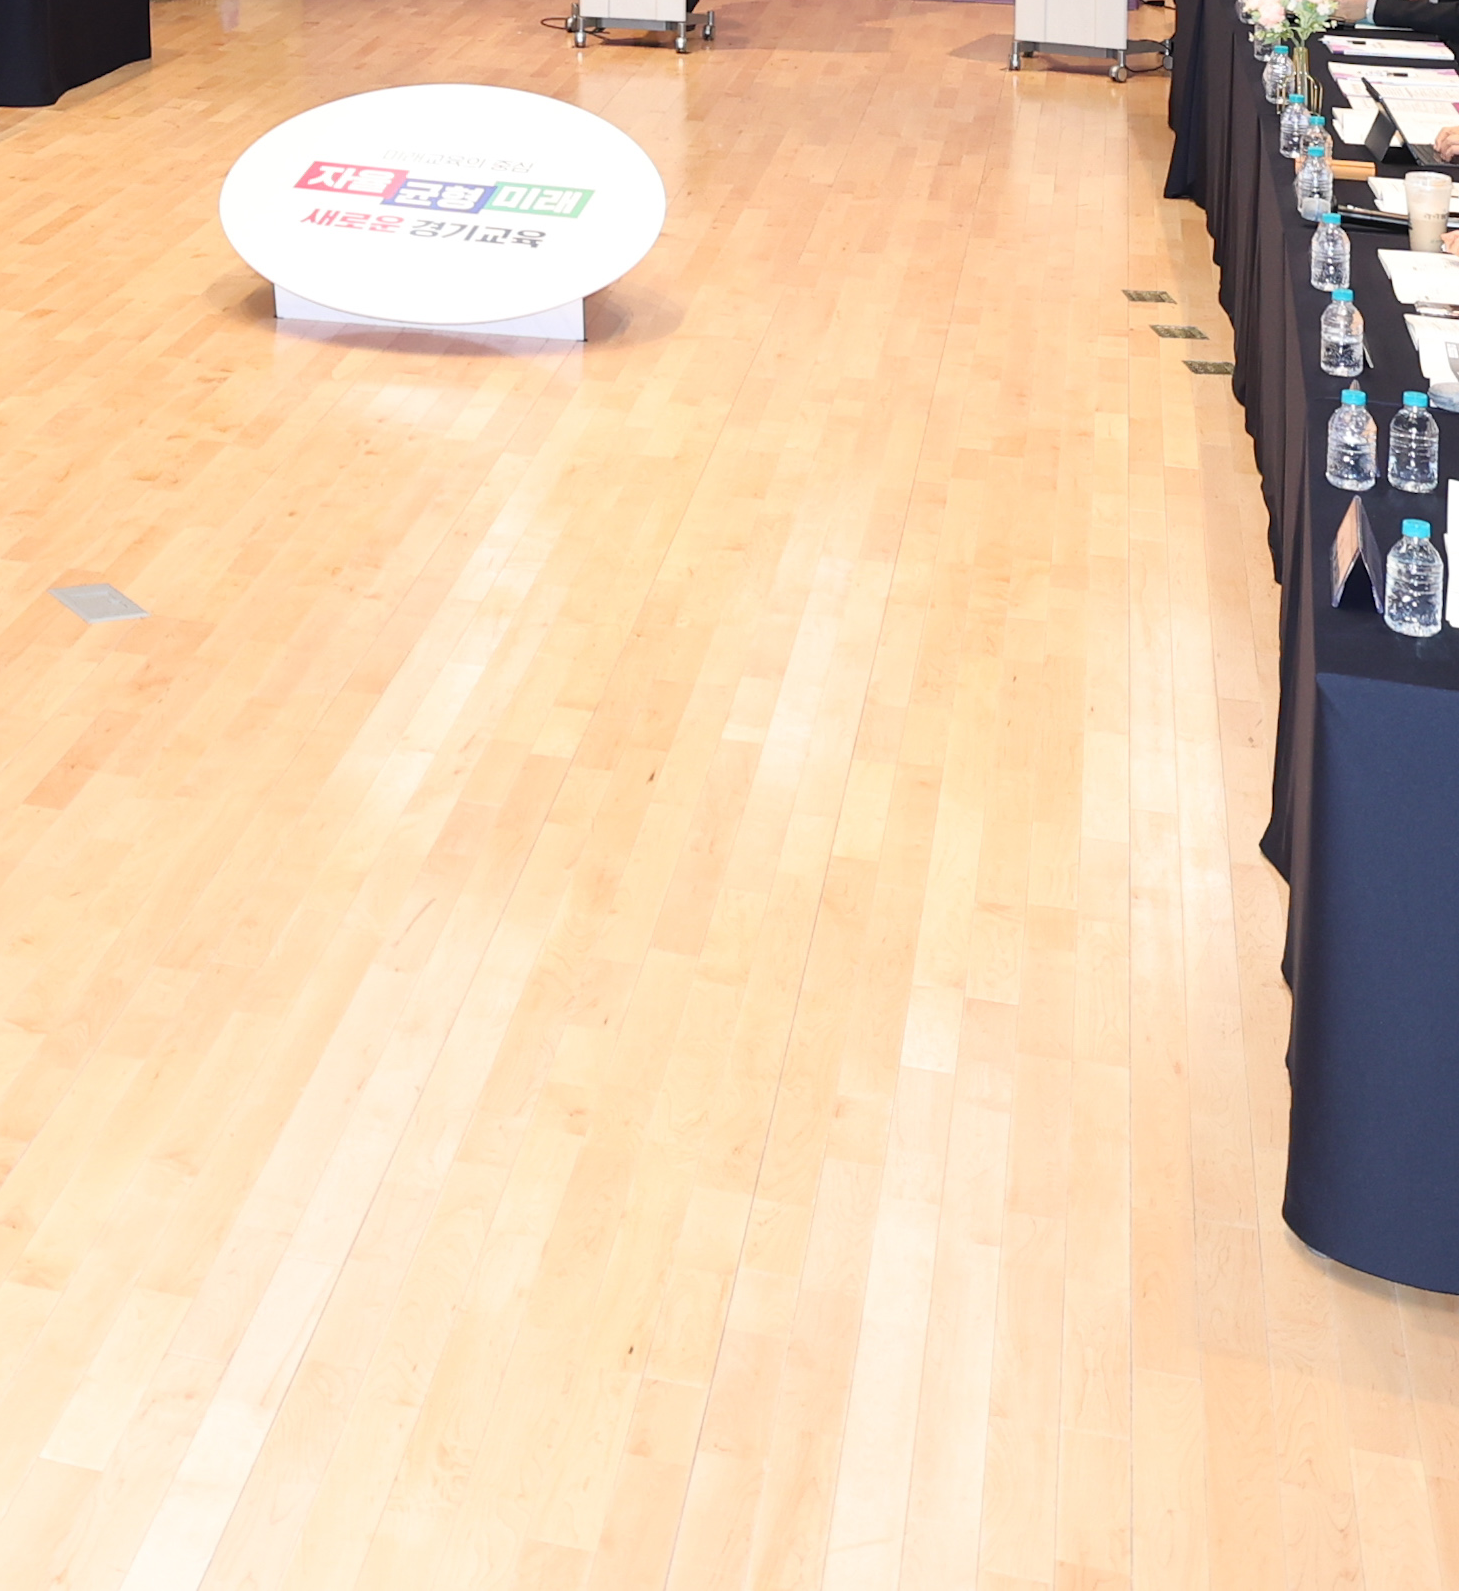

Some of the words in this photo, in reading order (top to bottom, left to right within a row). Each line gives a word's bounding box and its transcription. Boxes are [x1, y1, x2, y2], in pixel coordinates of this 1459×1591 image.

[382, 148, 486, 170] 미래교육의
[490, 159, 534, 174] 중심
[307, 164, 396, 195] 자율
[394, 180, 487, 211] 균형
[490, 186, 584, 216] 미래
[300, 207, 405, 233] 새로운
[409, 217, 548, 248] 경기교육
